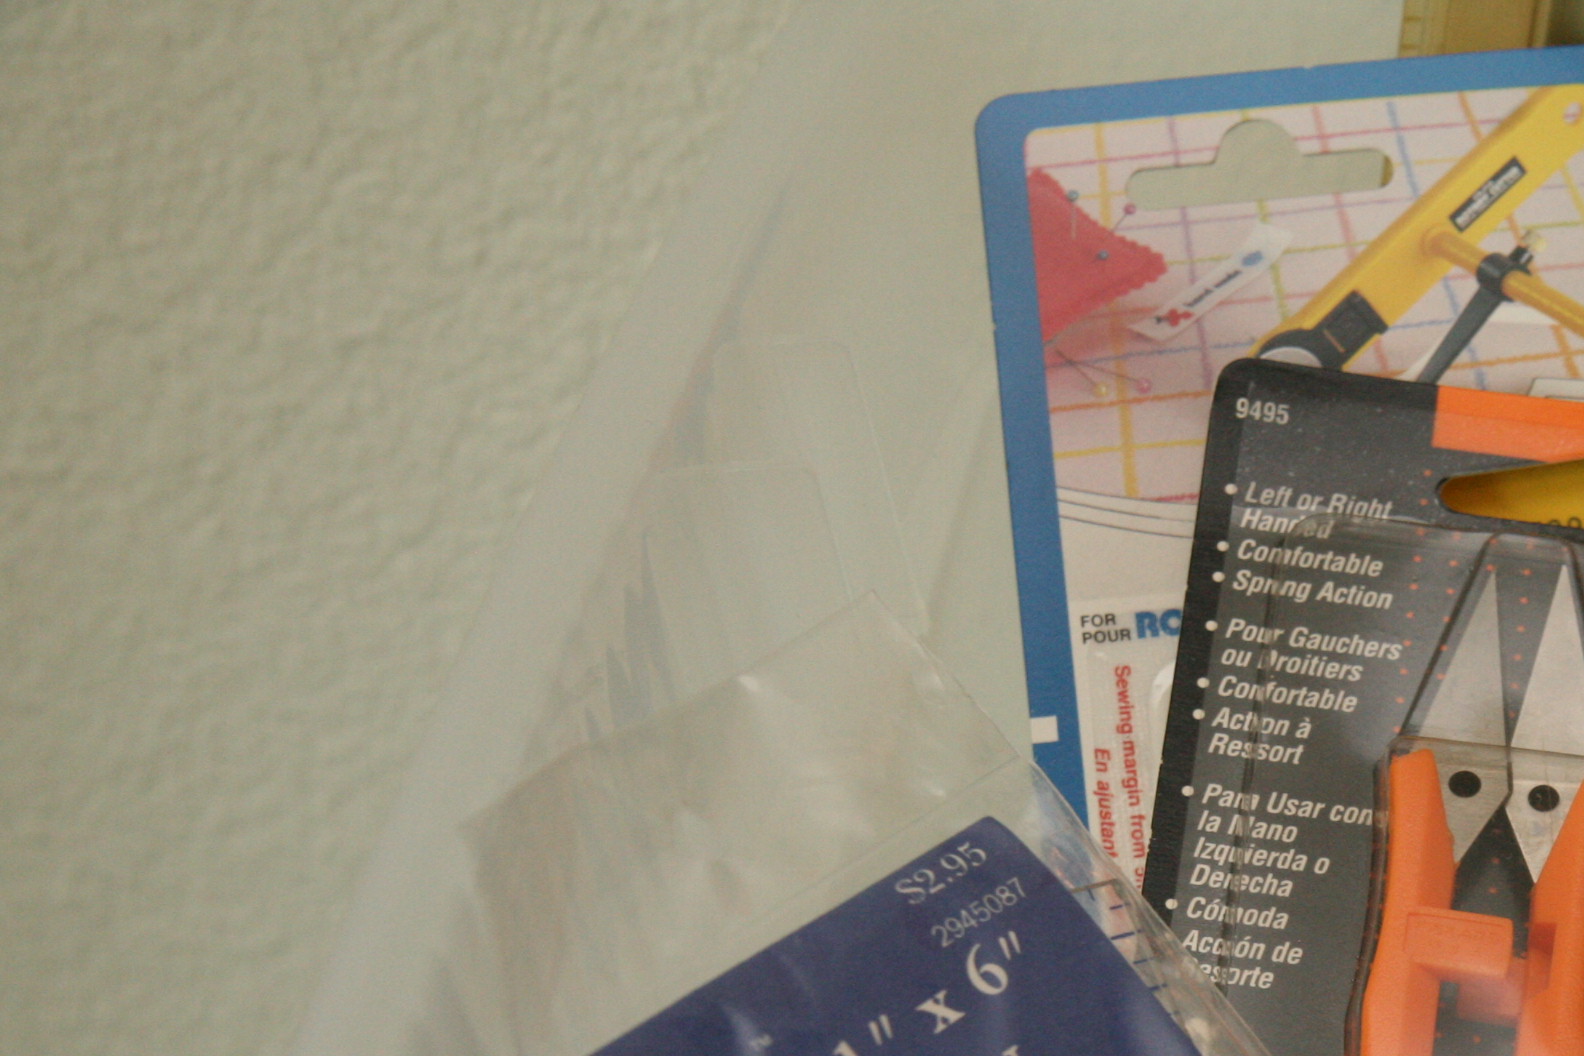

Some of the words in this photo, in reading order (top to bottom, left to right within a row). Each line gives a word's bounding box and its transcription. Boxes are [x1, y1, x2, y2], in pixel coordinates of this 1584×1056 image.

[1236, 397, 1289, 424] 9495
[1244, 481, 1293, 507] Left
[1296, 494, 1323, 512] or
[1327, 492, 1393, 519] Right
[1237, 539, 1384, 577] Comfortable
[1316, 581, 1394, 609] Action
[1080, 613, 1116, 628] FOR
[1081, 628, 1131, 645] POUR
[1225, 618, 1284, 643] Pour
[1289, 627, 1403, 660] Gauchers
[1221, 648, 1251, 667] ou
[1114, 665, 1135, 735] Sewing
[1295, 717, 1312, 739] à
[1094, 748, 1111, 773] En
[1208, 733, 1304, 765] Ressort
[1121, 739, 1144, 808] margin
[1198, 810, 1221, 832] la
[1266, 791, 1325, 819] Usar
[1129, 813, 1146, 859] from
[895, 842, 988, 906] $2.95
[1190, 864, 1294, 898] Derecha
[1314, 857, 1330, 875] o
[931, 877, 1028, 948] 2945087
[1272, 944, 1303, 965] de
[916, 990, 966, 1034] x
[965, 930, 1022, 997] 6"
[1190, 958, 1275, 990] esorte
